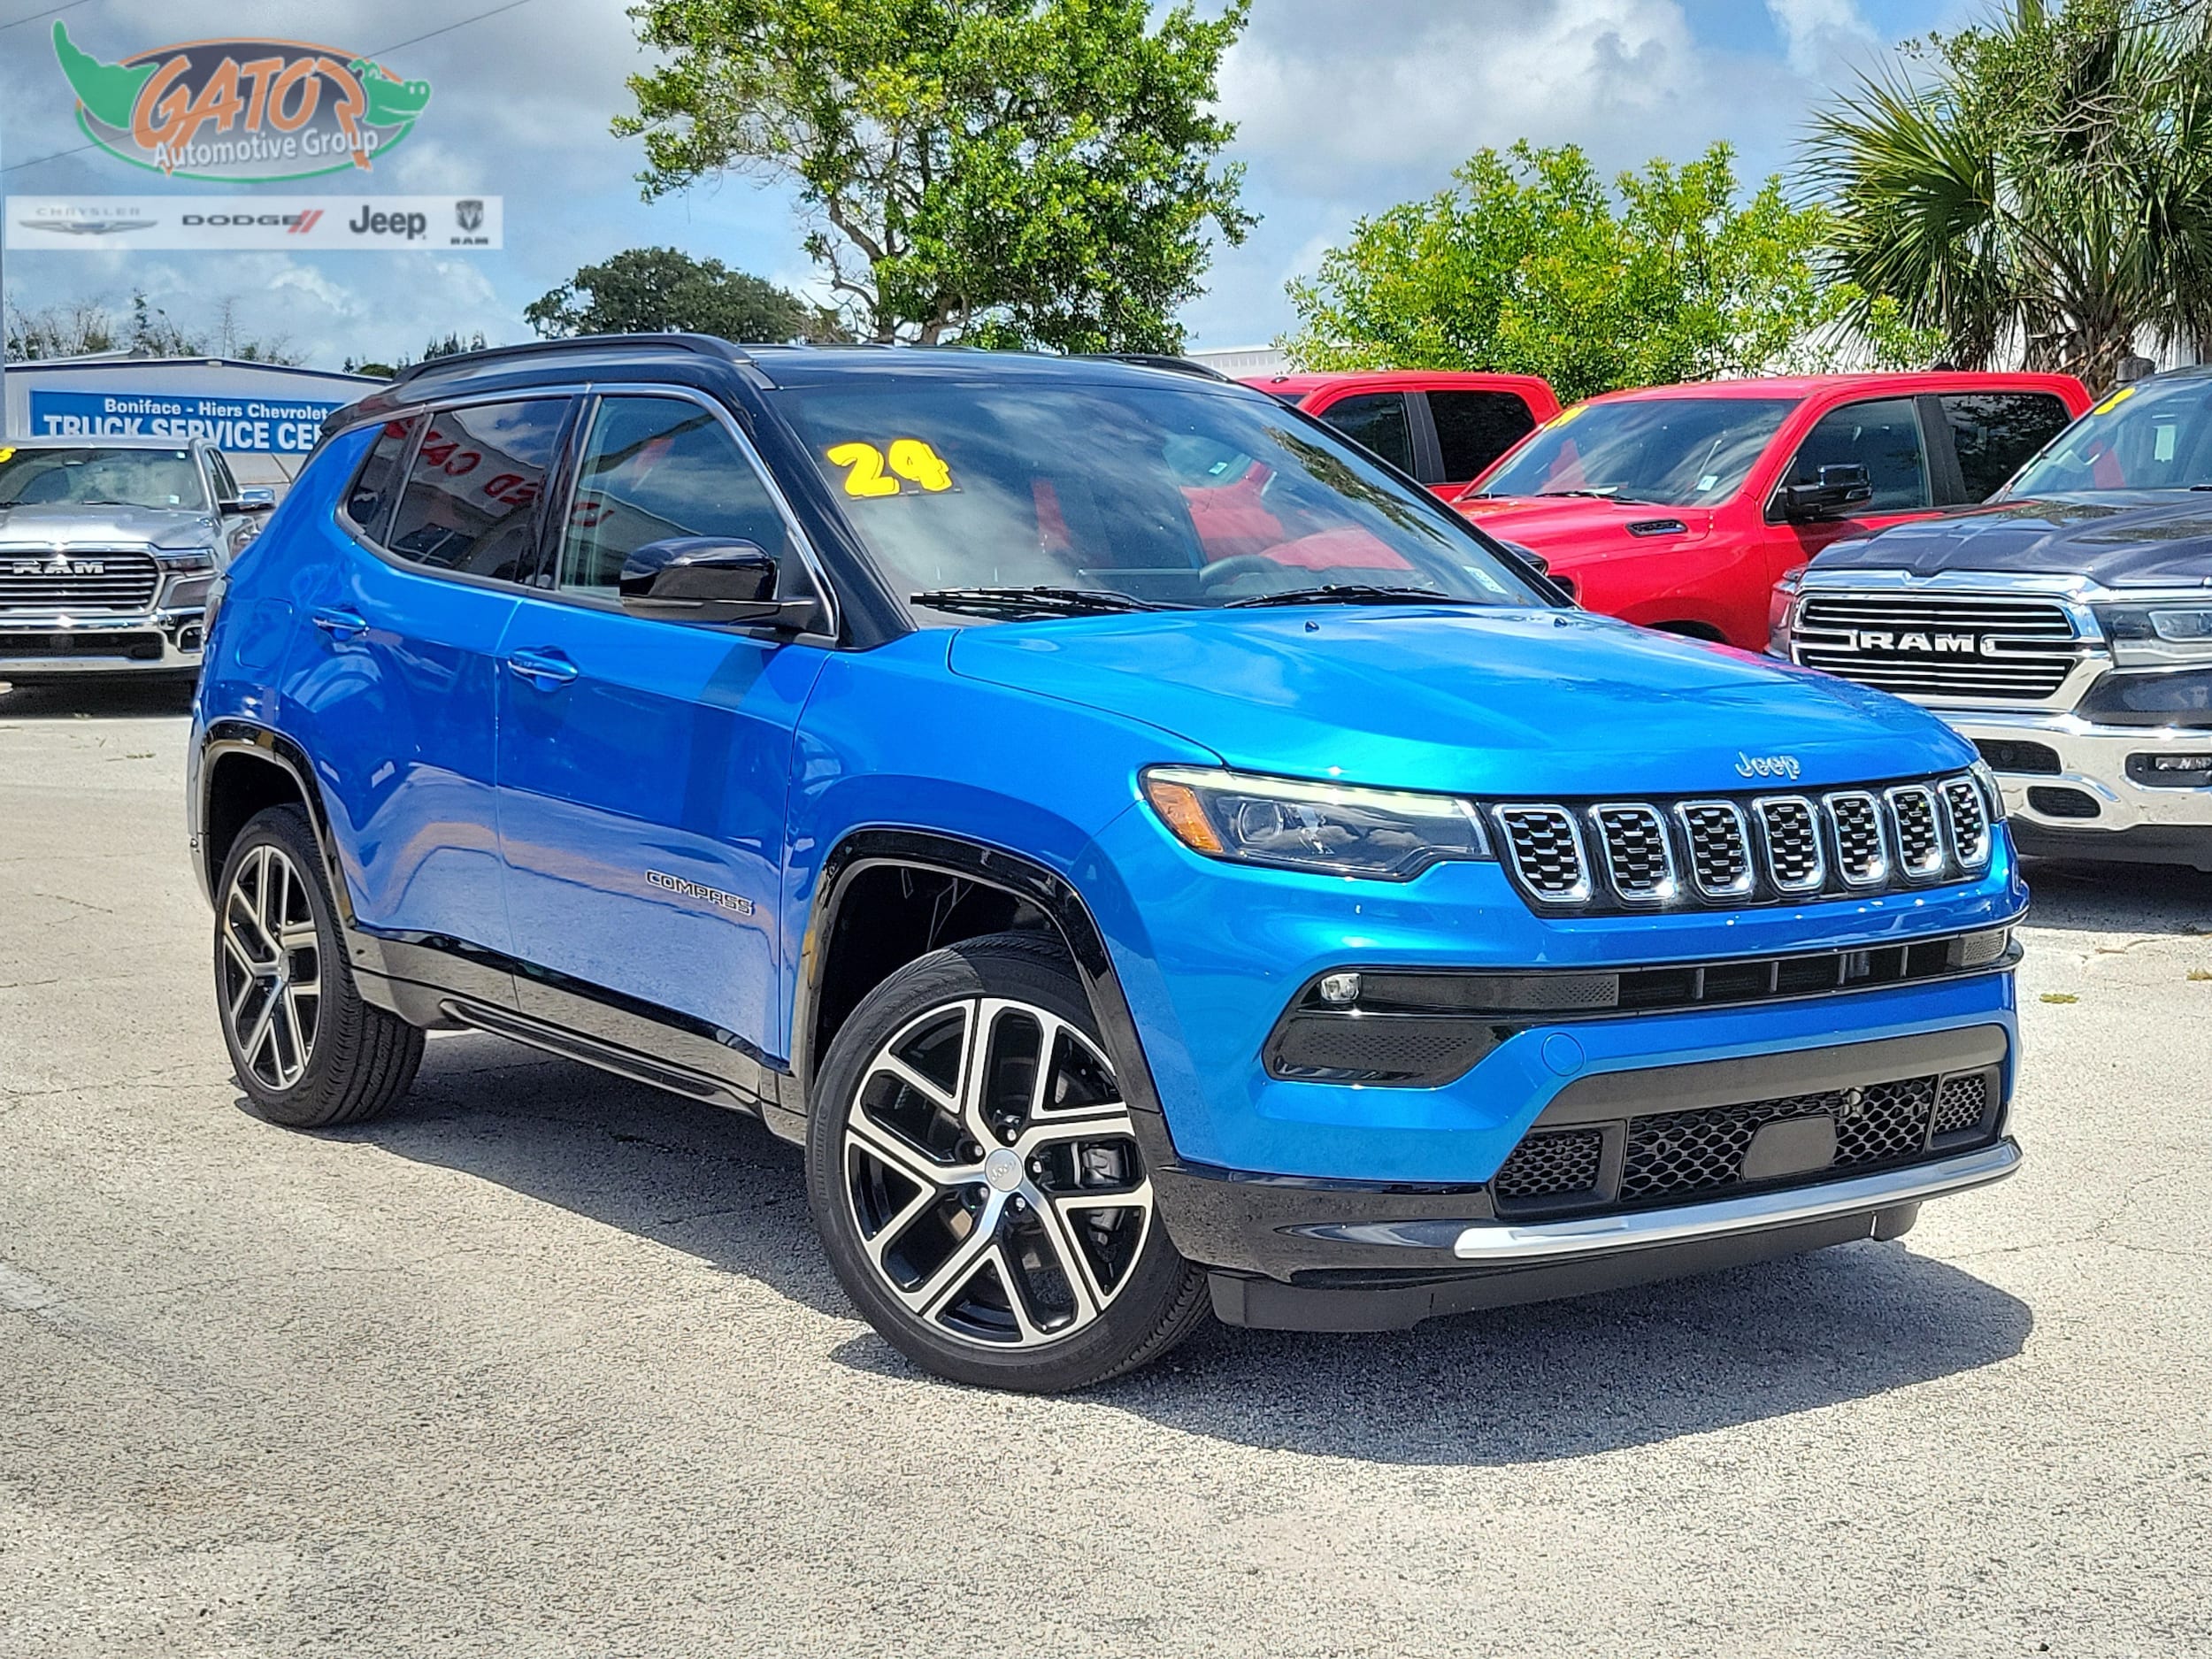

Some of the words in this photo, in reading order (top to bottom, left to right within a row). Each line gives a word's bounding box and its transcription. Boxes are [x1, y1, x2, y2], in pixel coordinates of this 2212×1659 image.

[104, 398, 181, 415] Boniface
[198, 401, 243, 418] Hiers
[247, 403, 328, 421] Chevrolet
[43, 415, 142, 436] TRUCK
[152, 418, 270, 449] SERVICE
[826, 438, 953, 496] 24
[12, 561, 105, 575] RAM
[1859, 630, 1976, 653] RAM
[1734, 750, 1801, 780] Jeep
[645, 869, 754, 917] COMPASS
